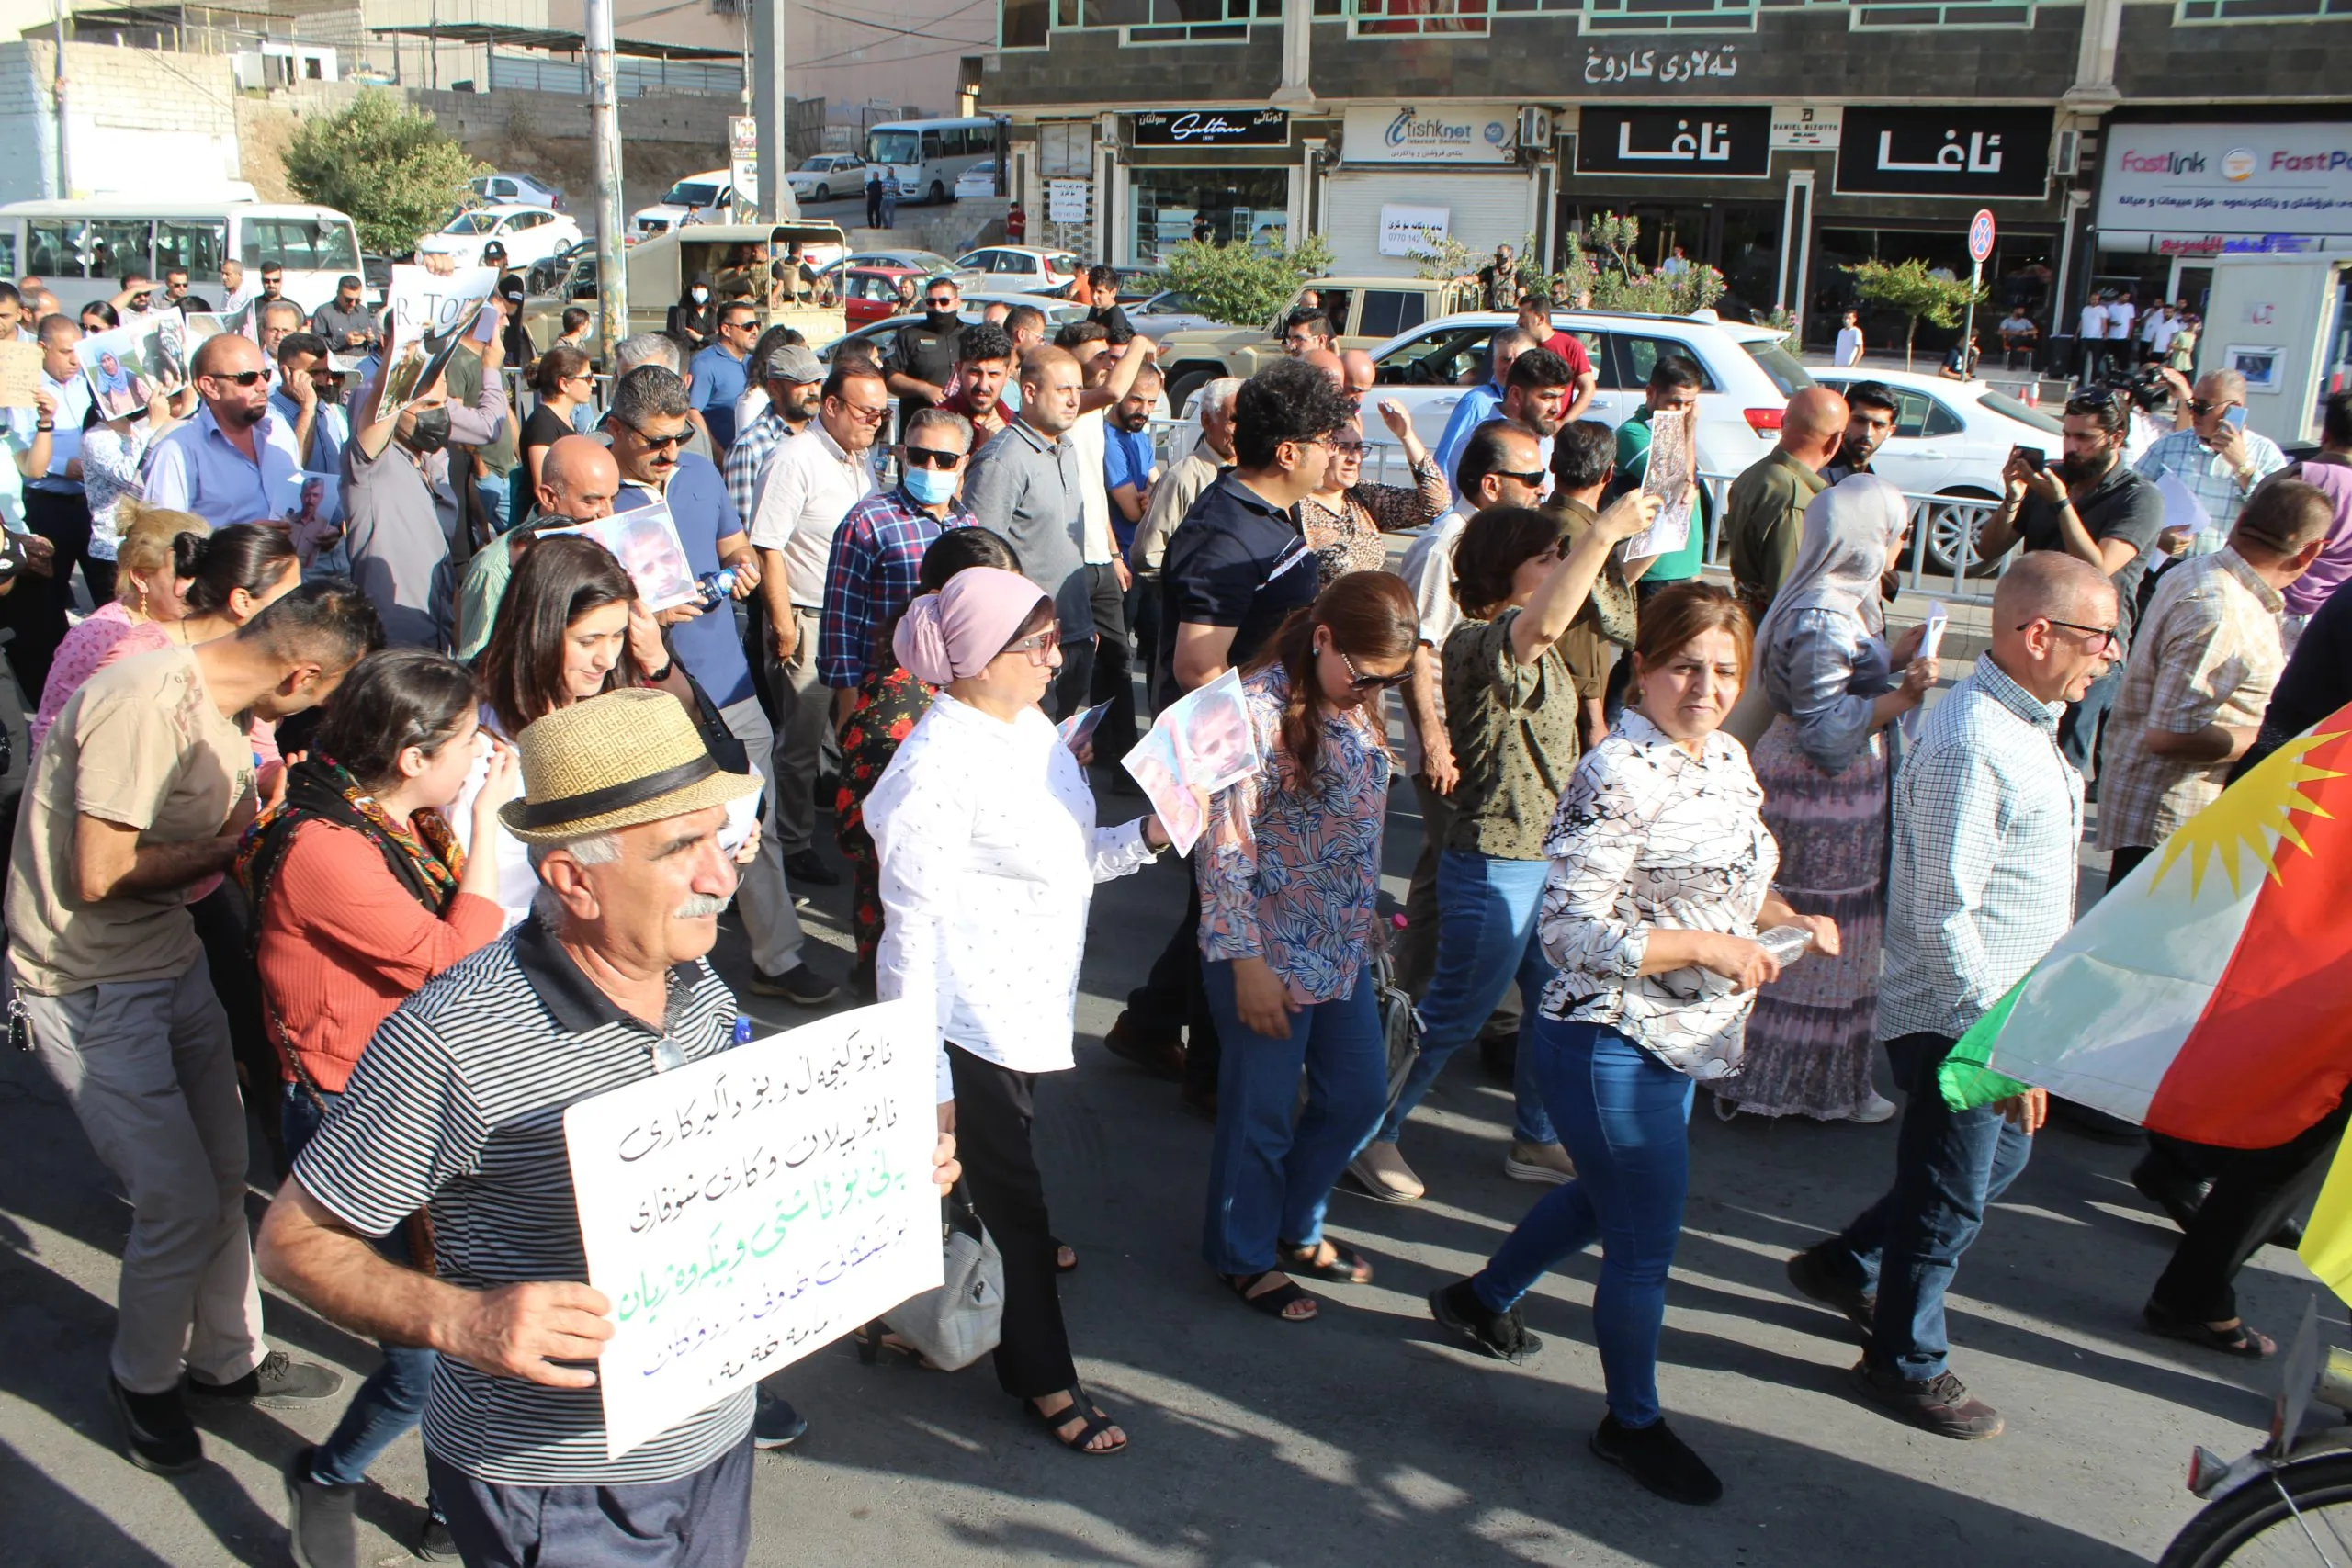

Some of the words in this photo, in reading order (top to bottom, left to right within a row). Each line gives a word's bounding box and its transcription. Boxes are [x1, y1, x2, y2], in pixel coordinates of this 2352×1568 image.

[1170, 113, 1247, 141] Sultan
[1388, 233, 1406, 243] 0770
[1408, 234, 1420, 243] 142
[856, 1044, 876, 1072] بۆ
[752, 1076, 773, 1111] بۆ
[779, 1082, 790, 1103] و
[860, 1104, 881, 1138] بۆ
[764, 1156, 777, 1181] و
[839, 1168, 864, 1214] بۆ
